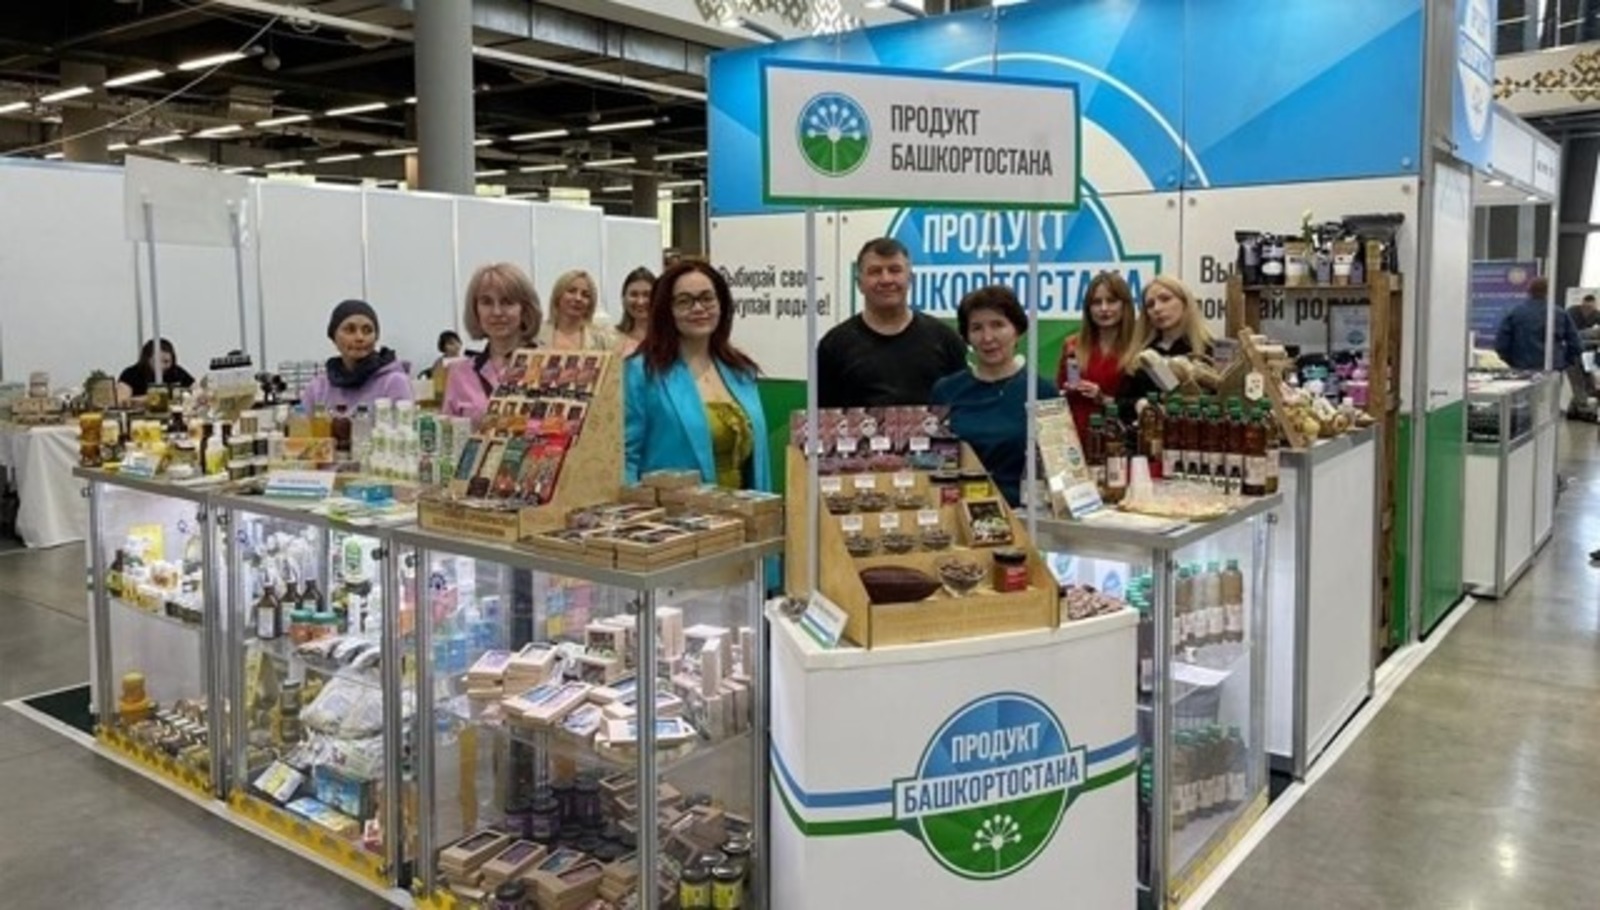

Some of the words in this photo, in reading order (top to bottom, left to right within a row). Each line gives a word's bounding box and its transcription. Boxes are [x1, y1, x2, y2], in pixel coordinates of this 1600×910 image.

[891, 104, 980, 138] ПРОДУКТ
[891, 143, 1053, 176] БАШКОРТОСТАНА
[923, 211, 1064, 259] ПРОДУКТ
[952, 721, 1041, 764] ПРОДУКТ
[904, 756, 1078, 813] БАШКОРТОСТАНА
